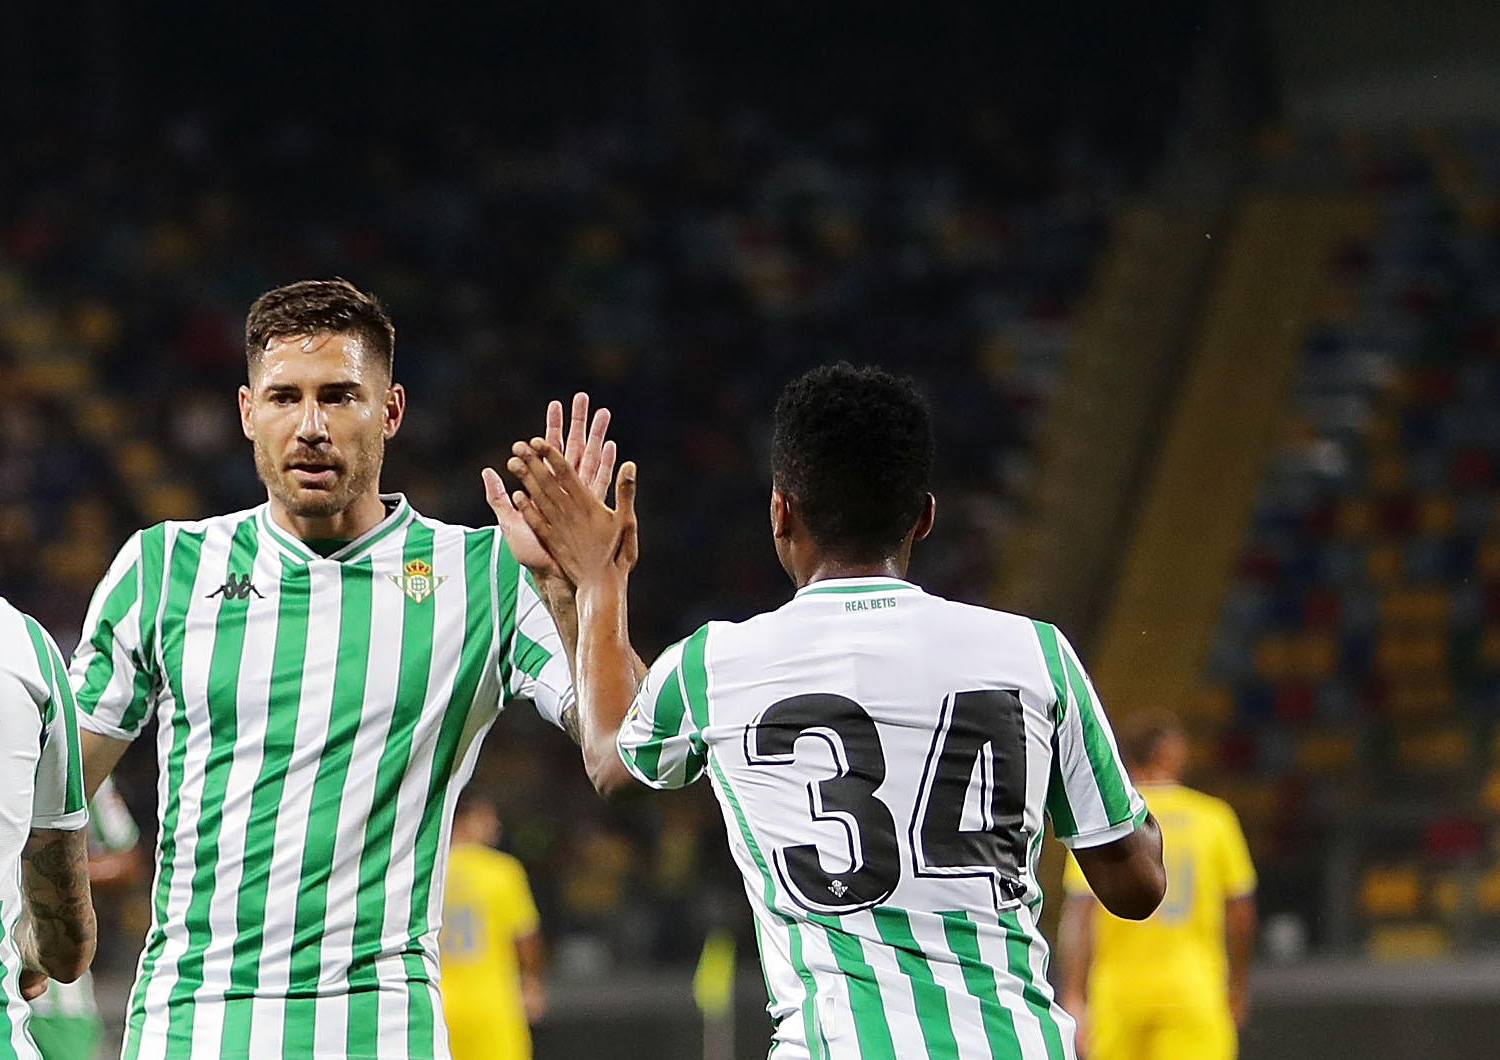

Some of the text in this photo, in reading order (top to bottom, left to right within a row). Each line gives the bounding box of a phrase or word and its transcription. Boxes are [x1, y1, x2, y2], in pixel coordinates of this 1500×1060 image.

[845, 597, 896, 612] REAL BETIS
[743, 689, 1027, 915] 34
